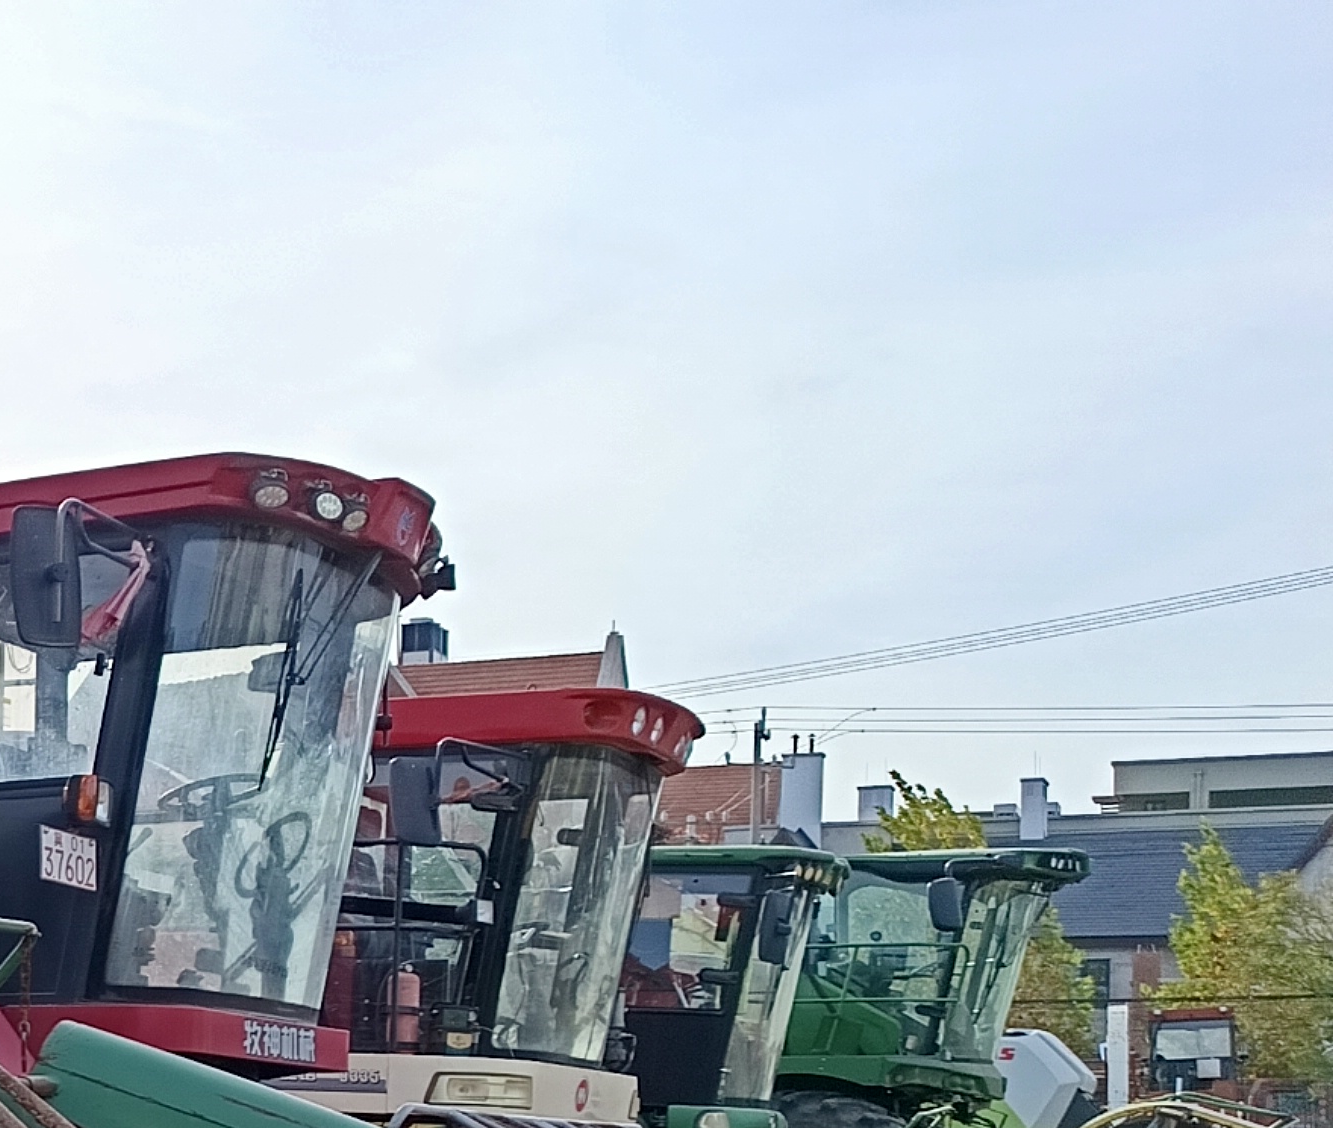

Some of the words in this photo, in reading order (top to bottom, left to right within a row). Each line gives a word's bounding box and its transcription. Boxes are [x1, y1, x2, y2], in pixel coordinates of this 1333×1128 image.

[44, 846, 95, 888] 37602
[243, 1019, 316, 1062] 牧神机械
